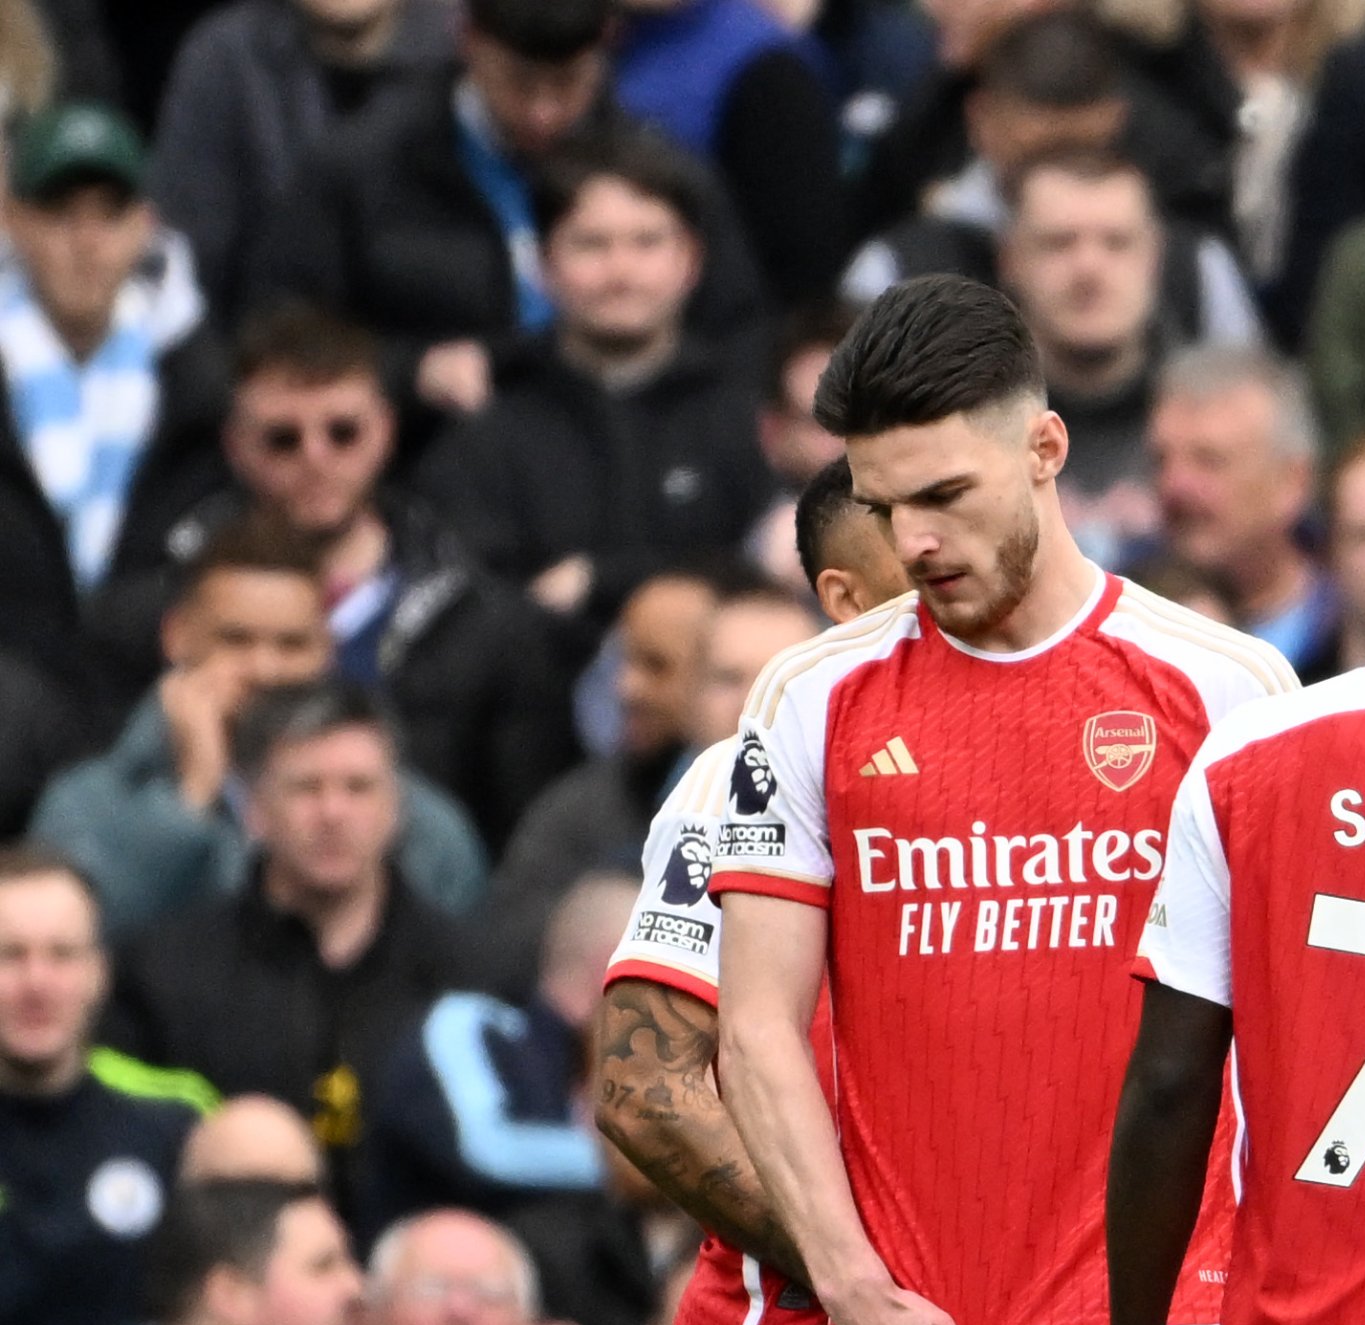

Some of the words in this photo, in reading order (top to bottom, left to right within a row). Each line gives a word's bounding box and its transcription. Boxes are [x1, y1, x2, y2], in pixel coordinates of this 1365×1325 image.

[1094, 725, 1146, 738] Arsenal
[732, 826, 778, 841] room
[715, 841, 731, 856] or
[732, 841, 785, 857] racism
[853, 820, 1163, 893] Emirates
[655, 913, 706, 940] room
[899, 901, 962, 956] FLY
[973, 894, 1118, 952] BETTER
[631, 926, 650, 942] or
[649, 928, 709, 955] racism
